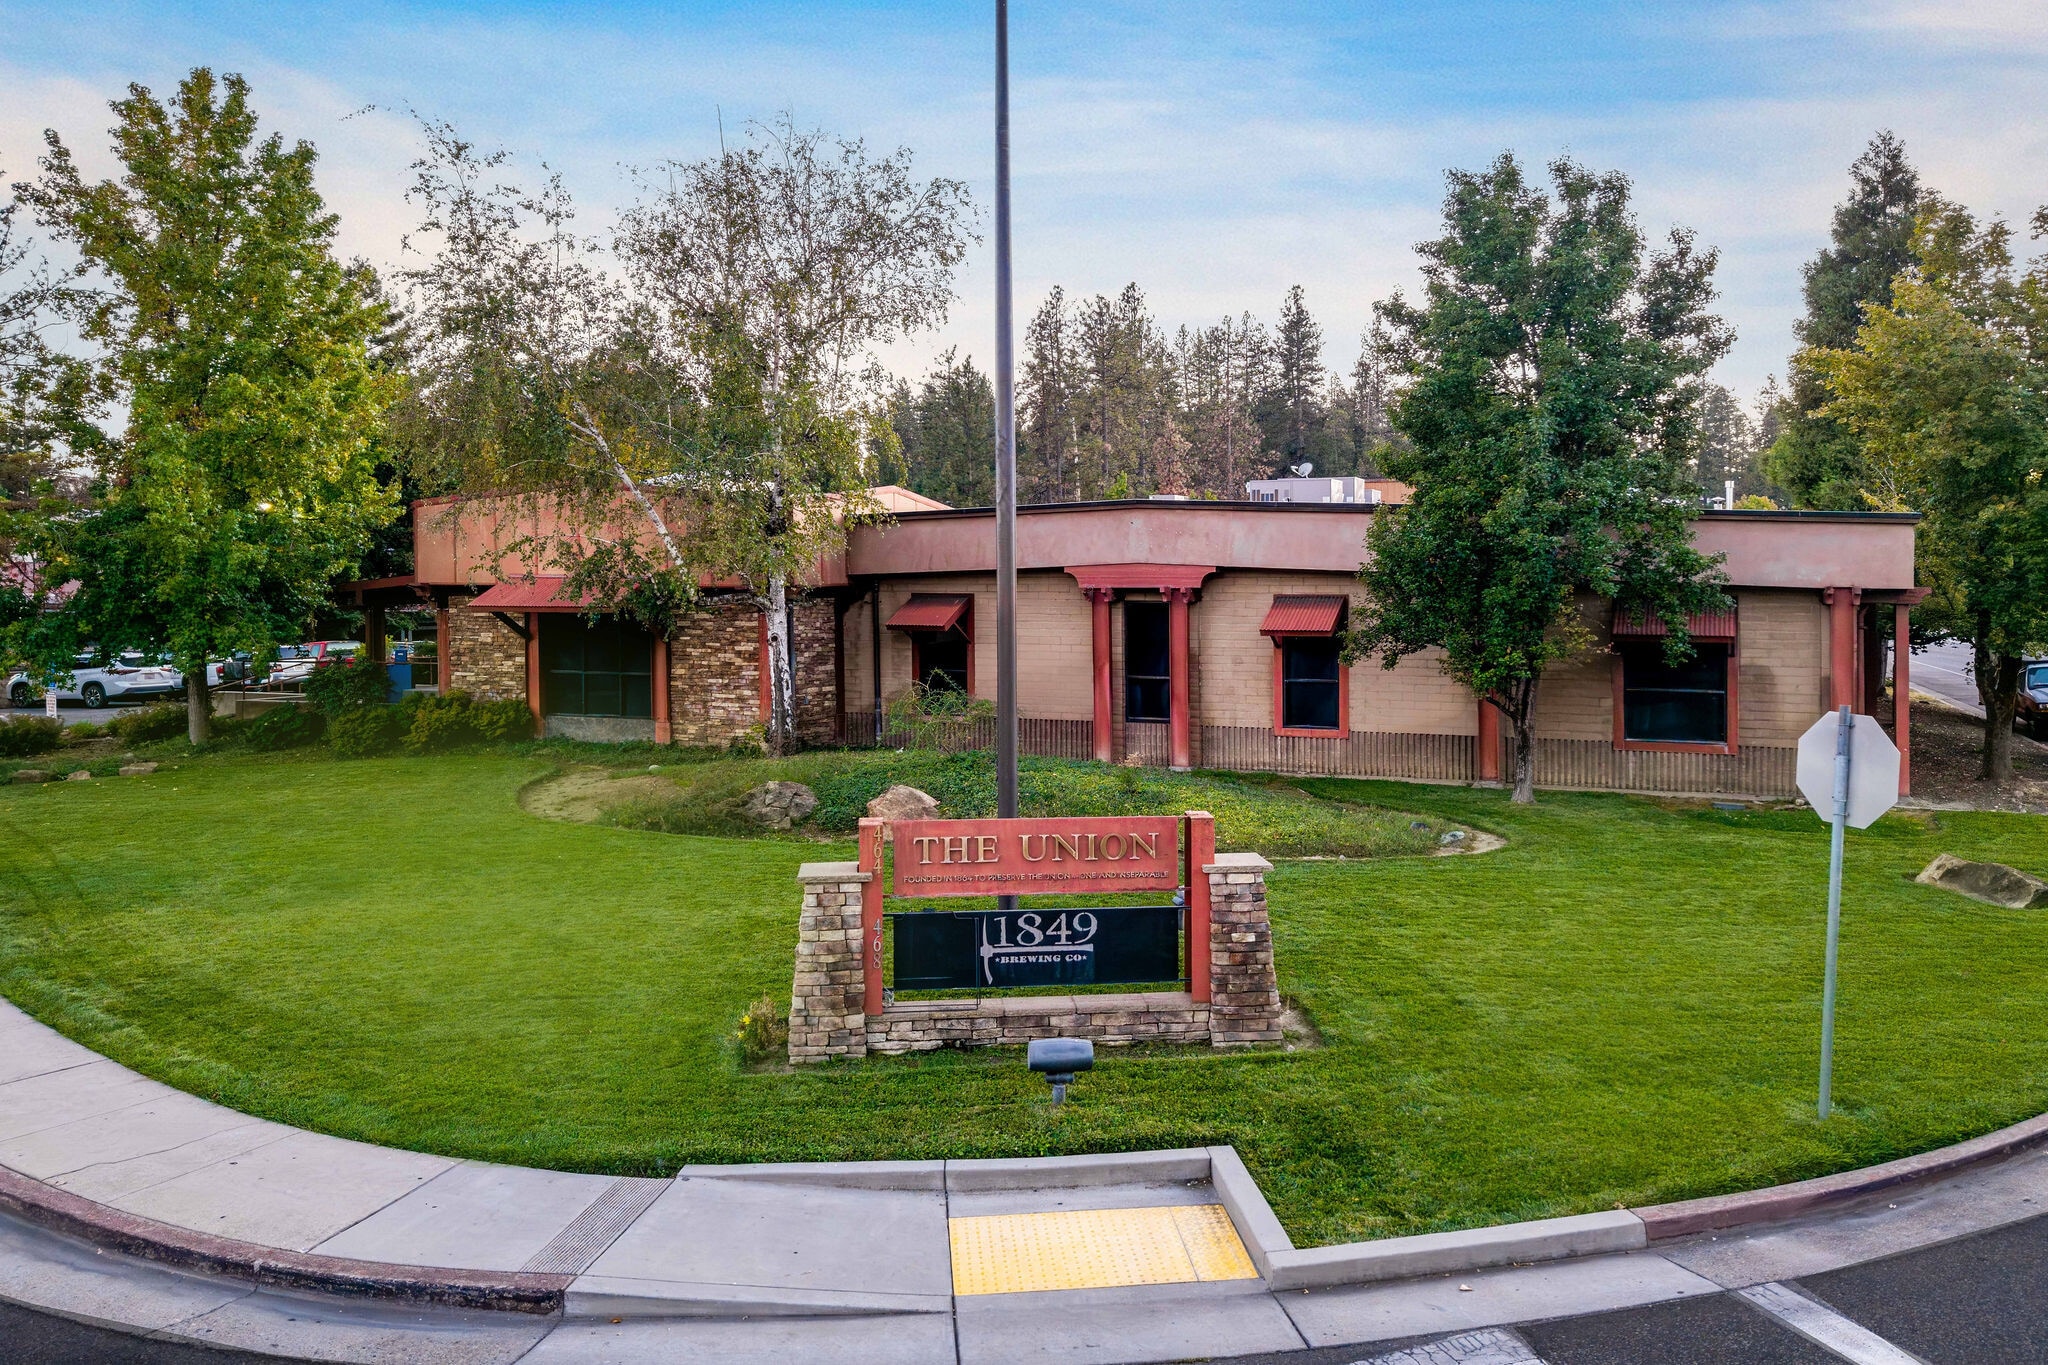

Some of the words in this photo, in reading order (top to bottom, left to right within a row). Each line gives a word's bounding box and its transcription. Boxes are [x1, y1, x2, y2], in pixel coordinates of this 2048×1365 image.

[873, 825, 882, 874] 464
[913, 835, 999, 865] THE
[1018, 832, 1160, 862] UNION
[903, 875, 942, 883] FOUNDED
[954, 874, 973, 882] 1864
[988, 873, 1026, 881] PRESERVE
[1099, 871, 1117, 879] AND
[873, 918, 882, 969] 468
[994, 912, 1098, 947] 1849
[1000, 954, 1061, 964] BREWING
